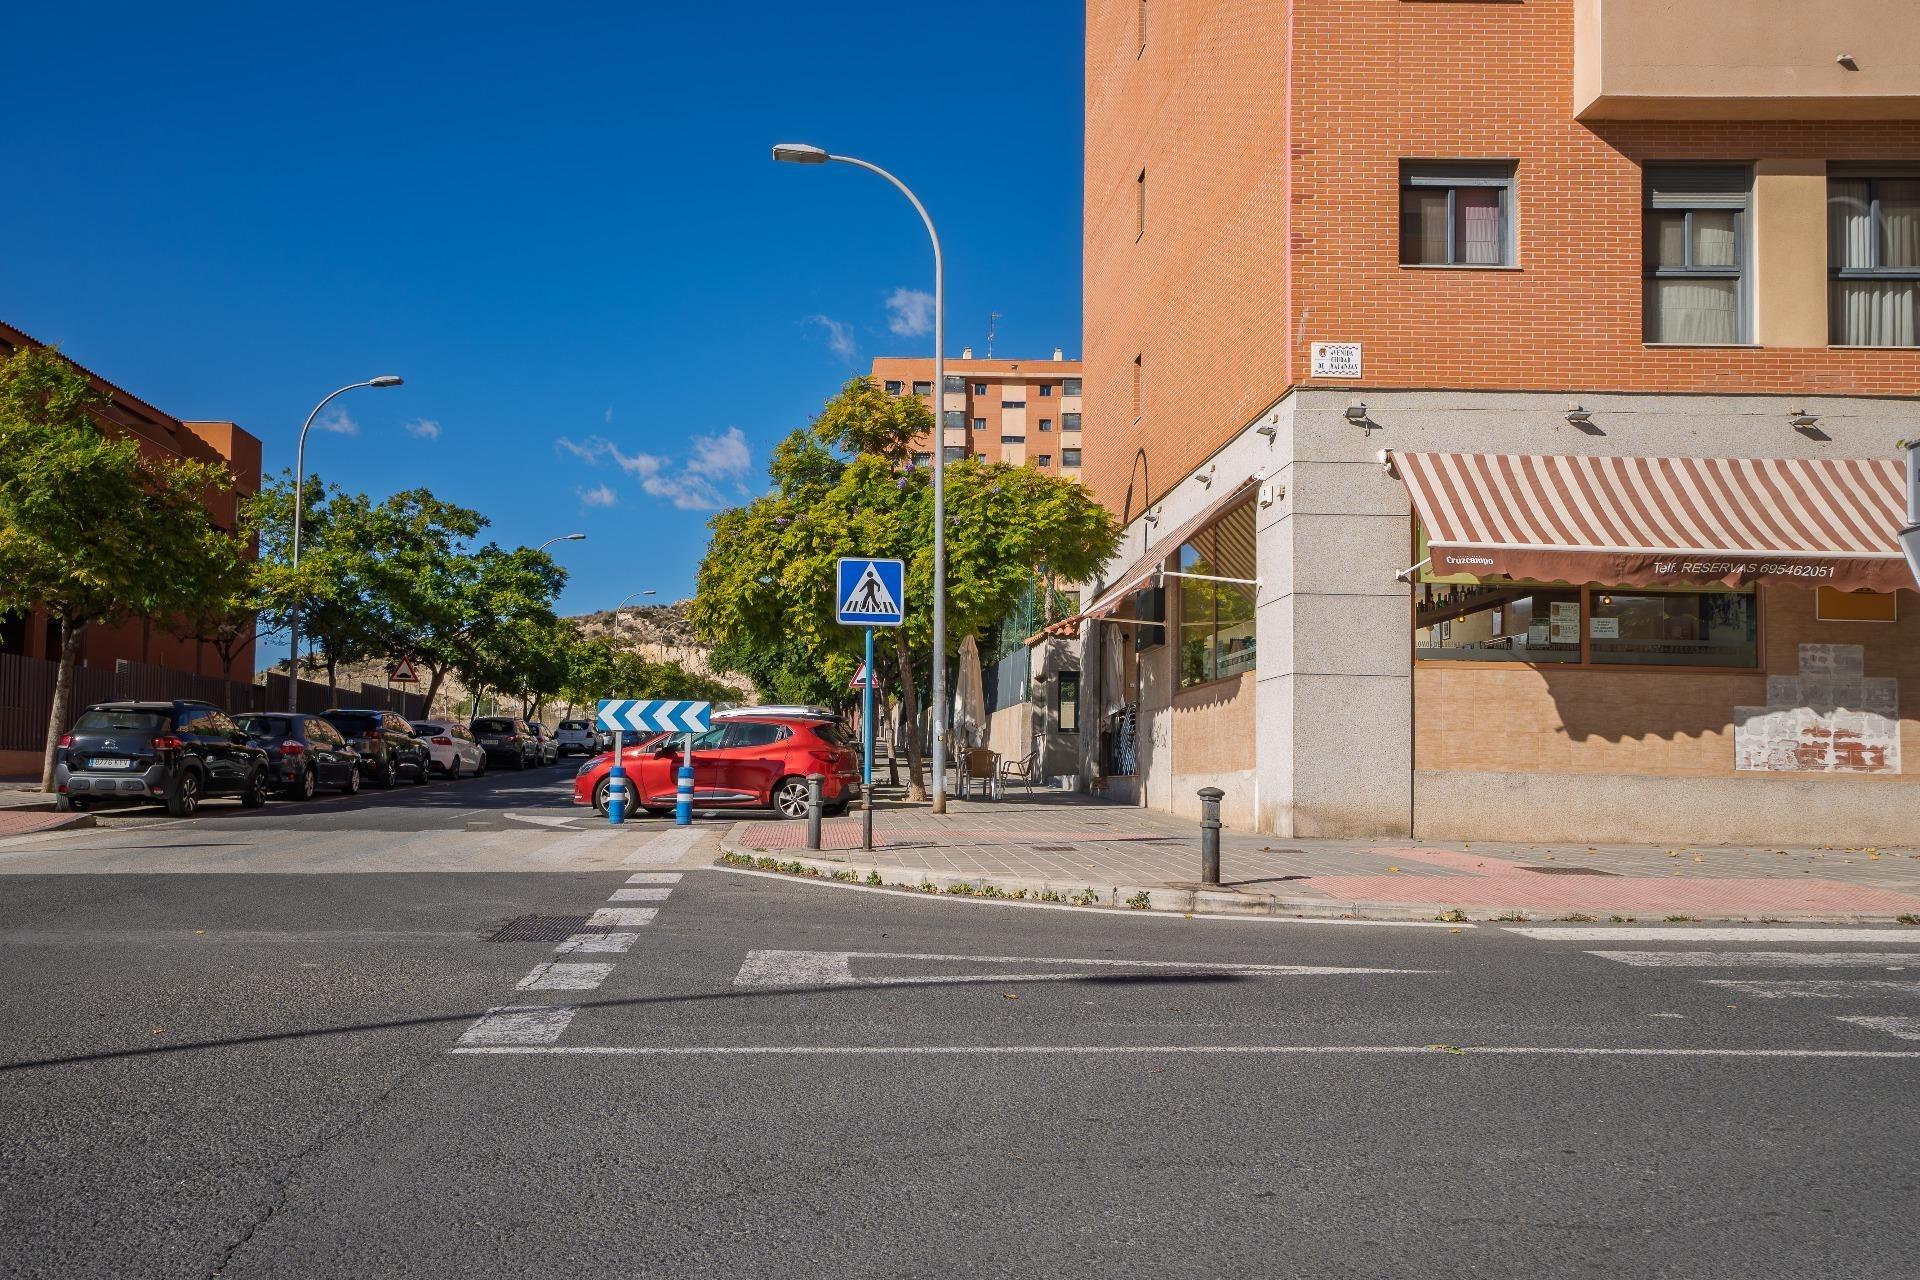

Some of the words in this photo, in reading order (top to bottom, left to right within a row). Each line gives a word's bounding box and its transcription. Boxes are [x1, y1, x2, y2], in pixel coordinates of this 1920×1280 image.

[1446, 555, 1494, 566] Cruzcampo
[1653, 562, 1677, 574] Telf.
[1680, 562, 1758, 574] RESERVAS
[1760, 563, 1836, 578] 695462051
